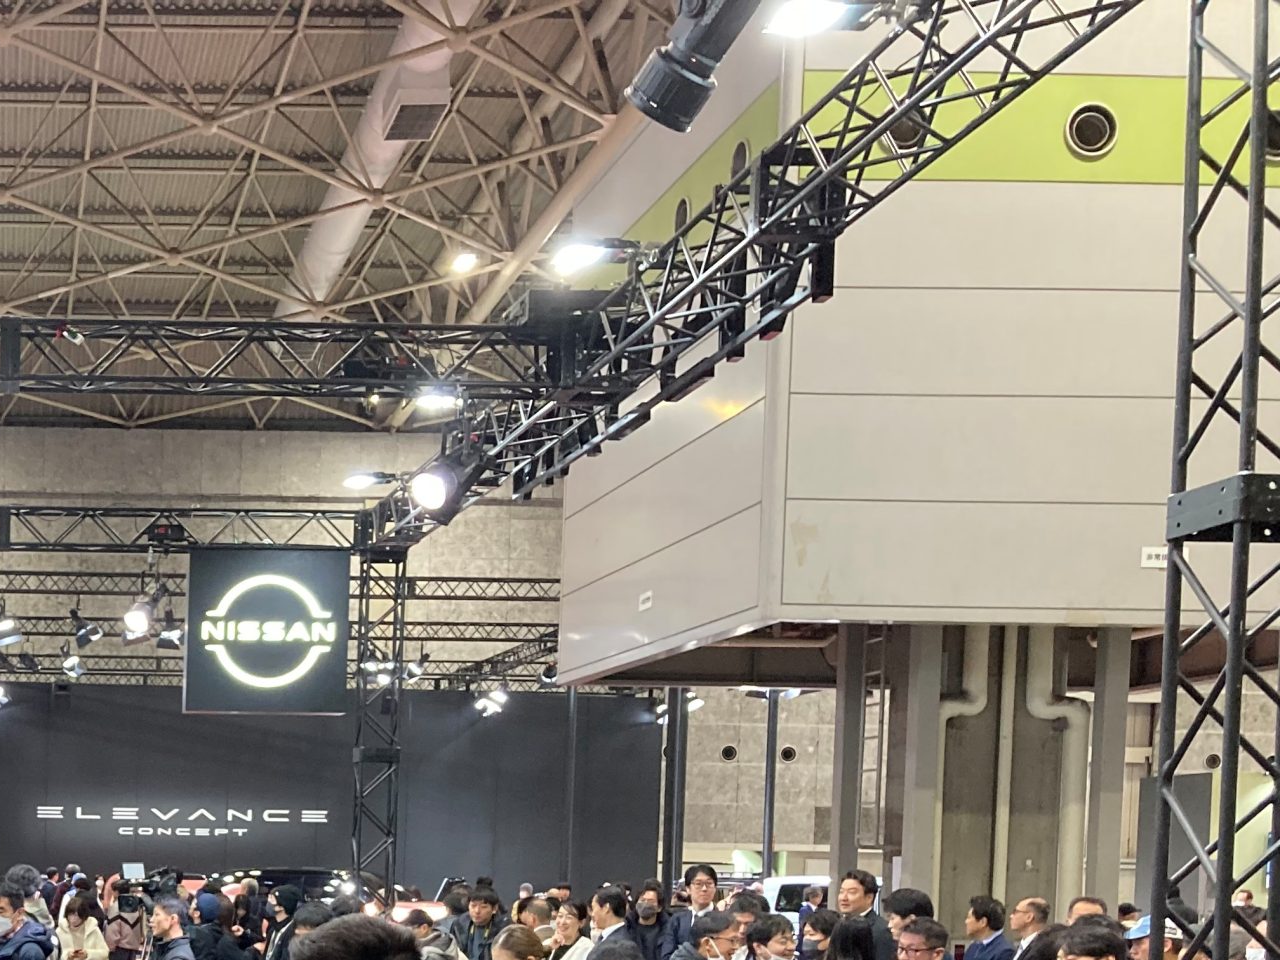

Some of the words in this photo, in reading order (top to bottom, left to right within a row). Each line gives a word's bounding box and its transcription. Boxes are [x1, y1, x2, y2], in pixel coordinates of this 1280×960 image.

[201, 620, 337, 642] NISSAN
[36, 805, 329, 823] ELEVANCE
[117, 826, 249, 837] CONCEPT
